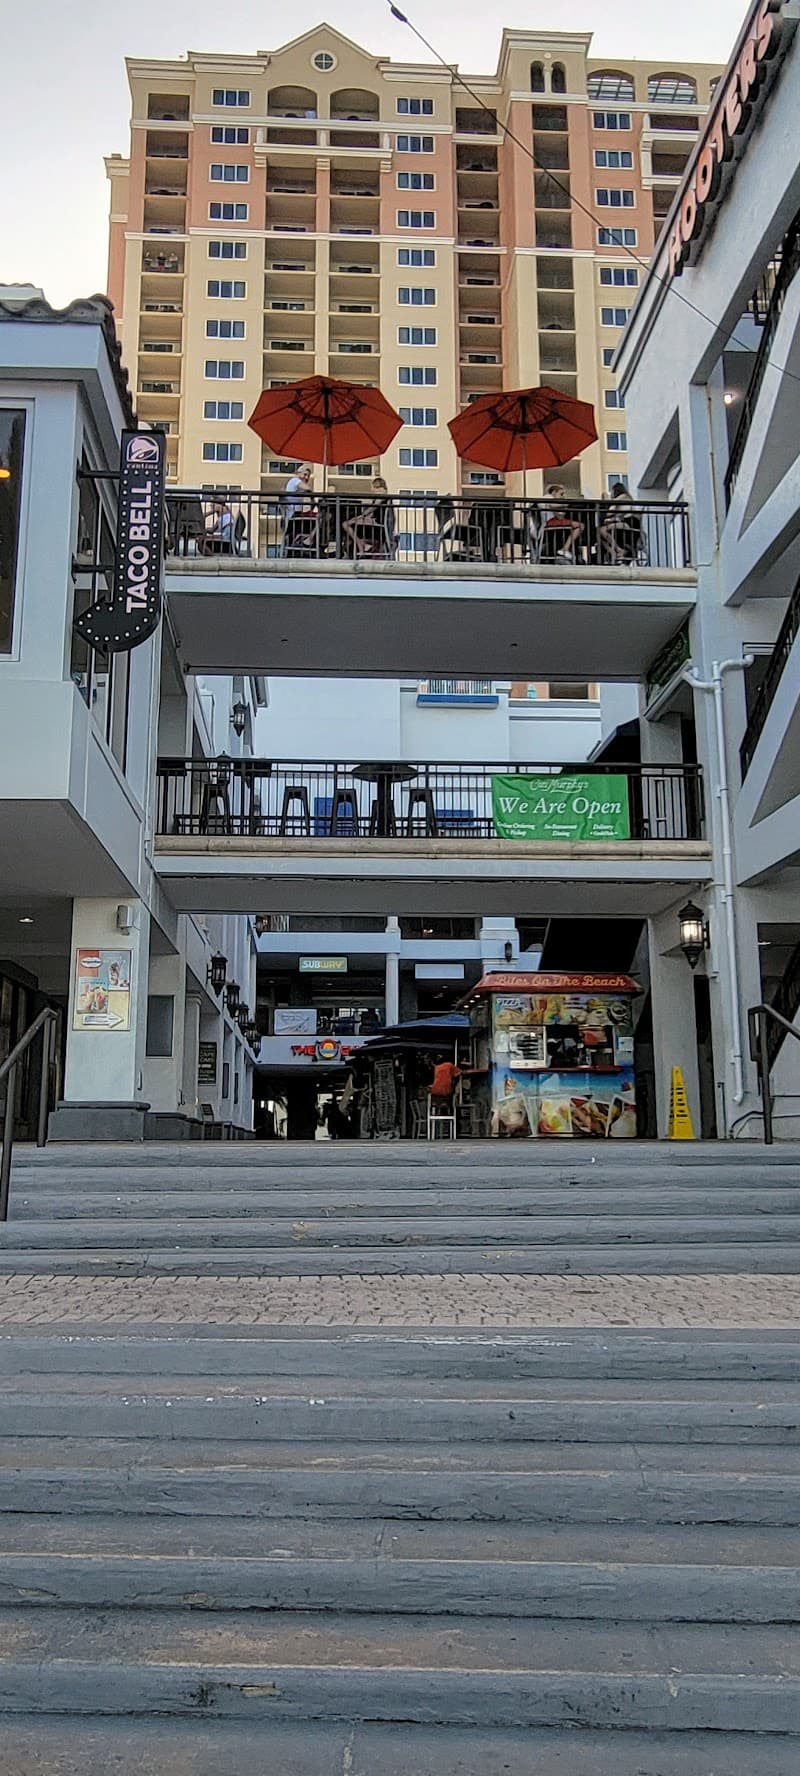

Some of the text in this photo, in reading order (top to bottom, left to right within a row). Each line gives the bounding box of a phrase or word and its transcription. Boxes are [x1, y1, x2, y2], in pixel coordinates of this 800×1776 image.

[667, 0, 774, 277] HOOTERS
[126, 480, 152, 614] TACO BELL
[498, 796, 622, 819] We Are Open
[302, 960, 345, 969] SUBWAY
[496, 974, 627, 987] Bites On The Beach
